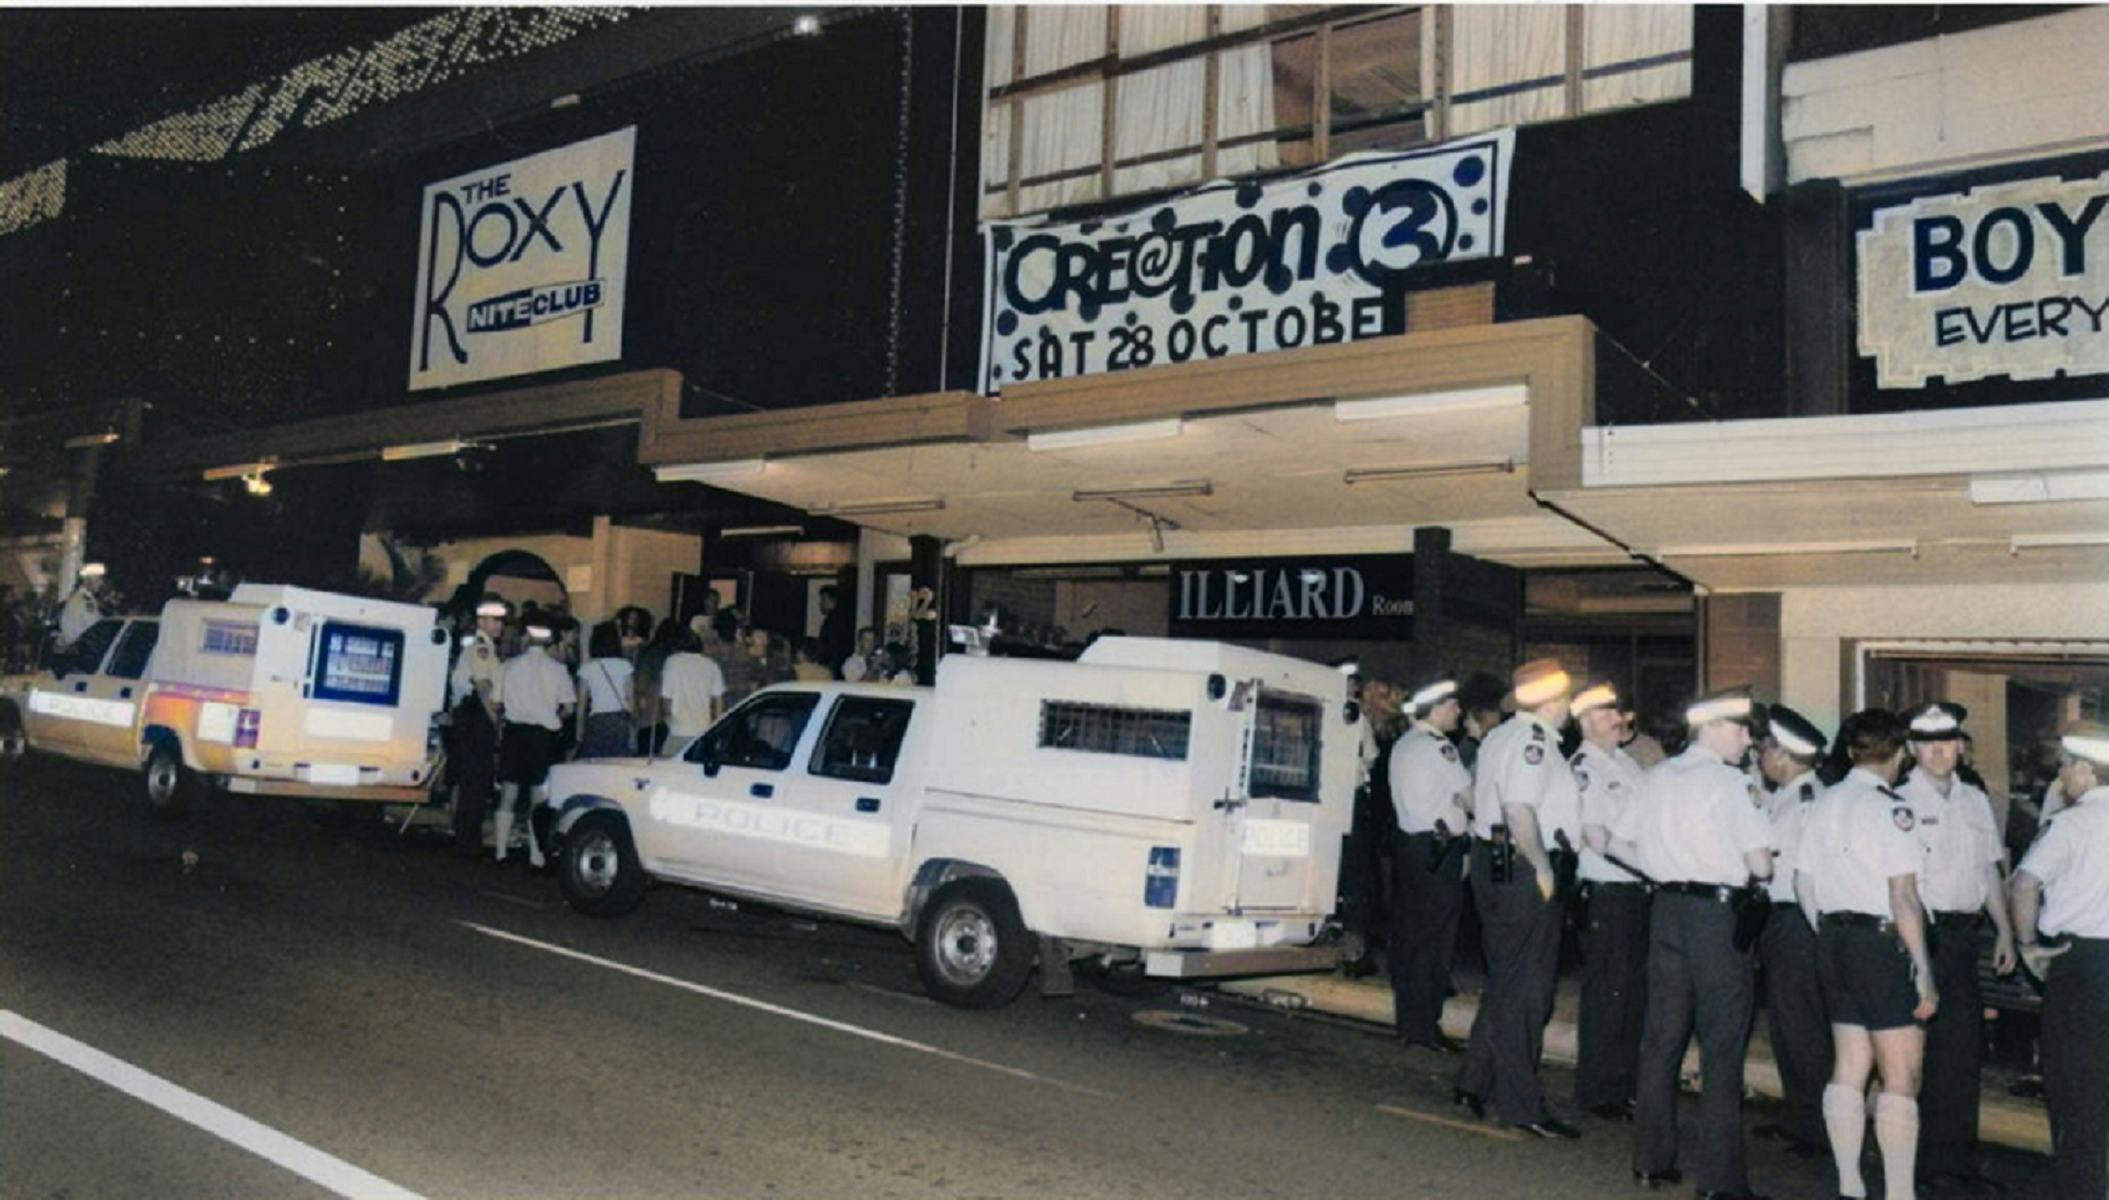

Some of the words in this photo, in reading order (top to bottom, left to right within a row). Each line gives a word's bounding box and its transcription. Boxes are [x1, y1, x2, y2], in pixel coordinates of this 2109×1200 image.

[461, 173, 512, 204] THE
[1913, 193, 2109, 292] BOY
[419, 169, 626, 371] ROXY
[468, 283, 601, 330] NITECLUB
[1935, 296, 2109, 347] EVERY
[1012, 331, 1095, 380] SAT
[1107, 325, 1155, 372] 28
[693, 800, 848, 847] POLICE
